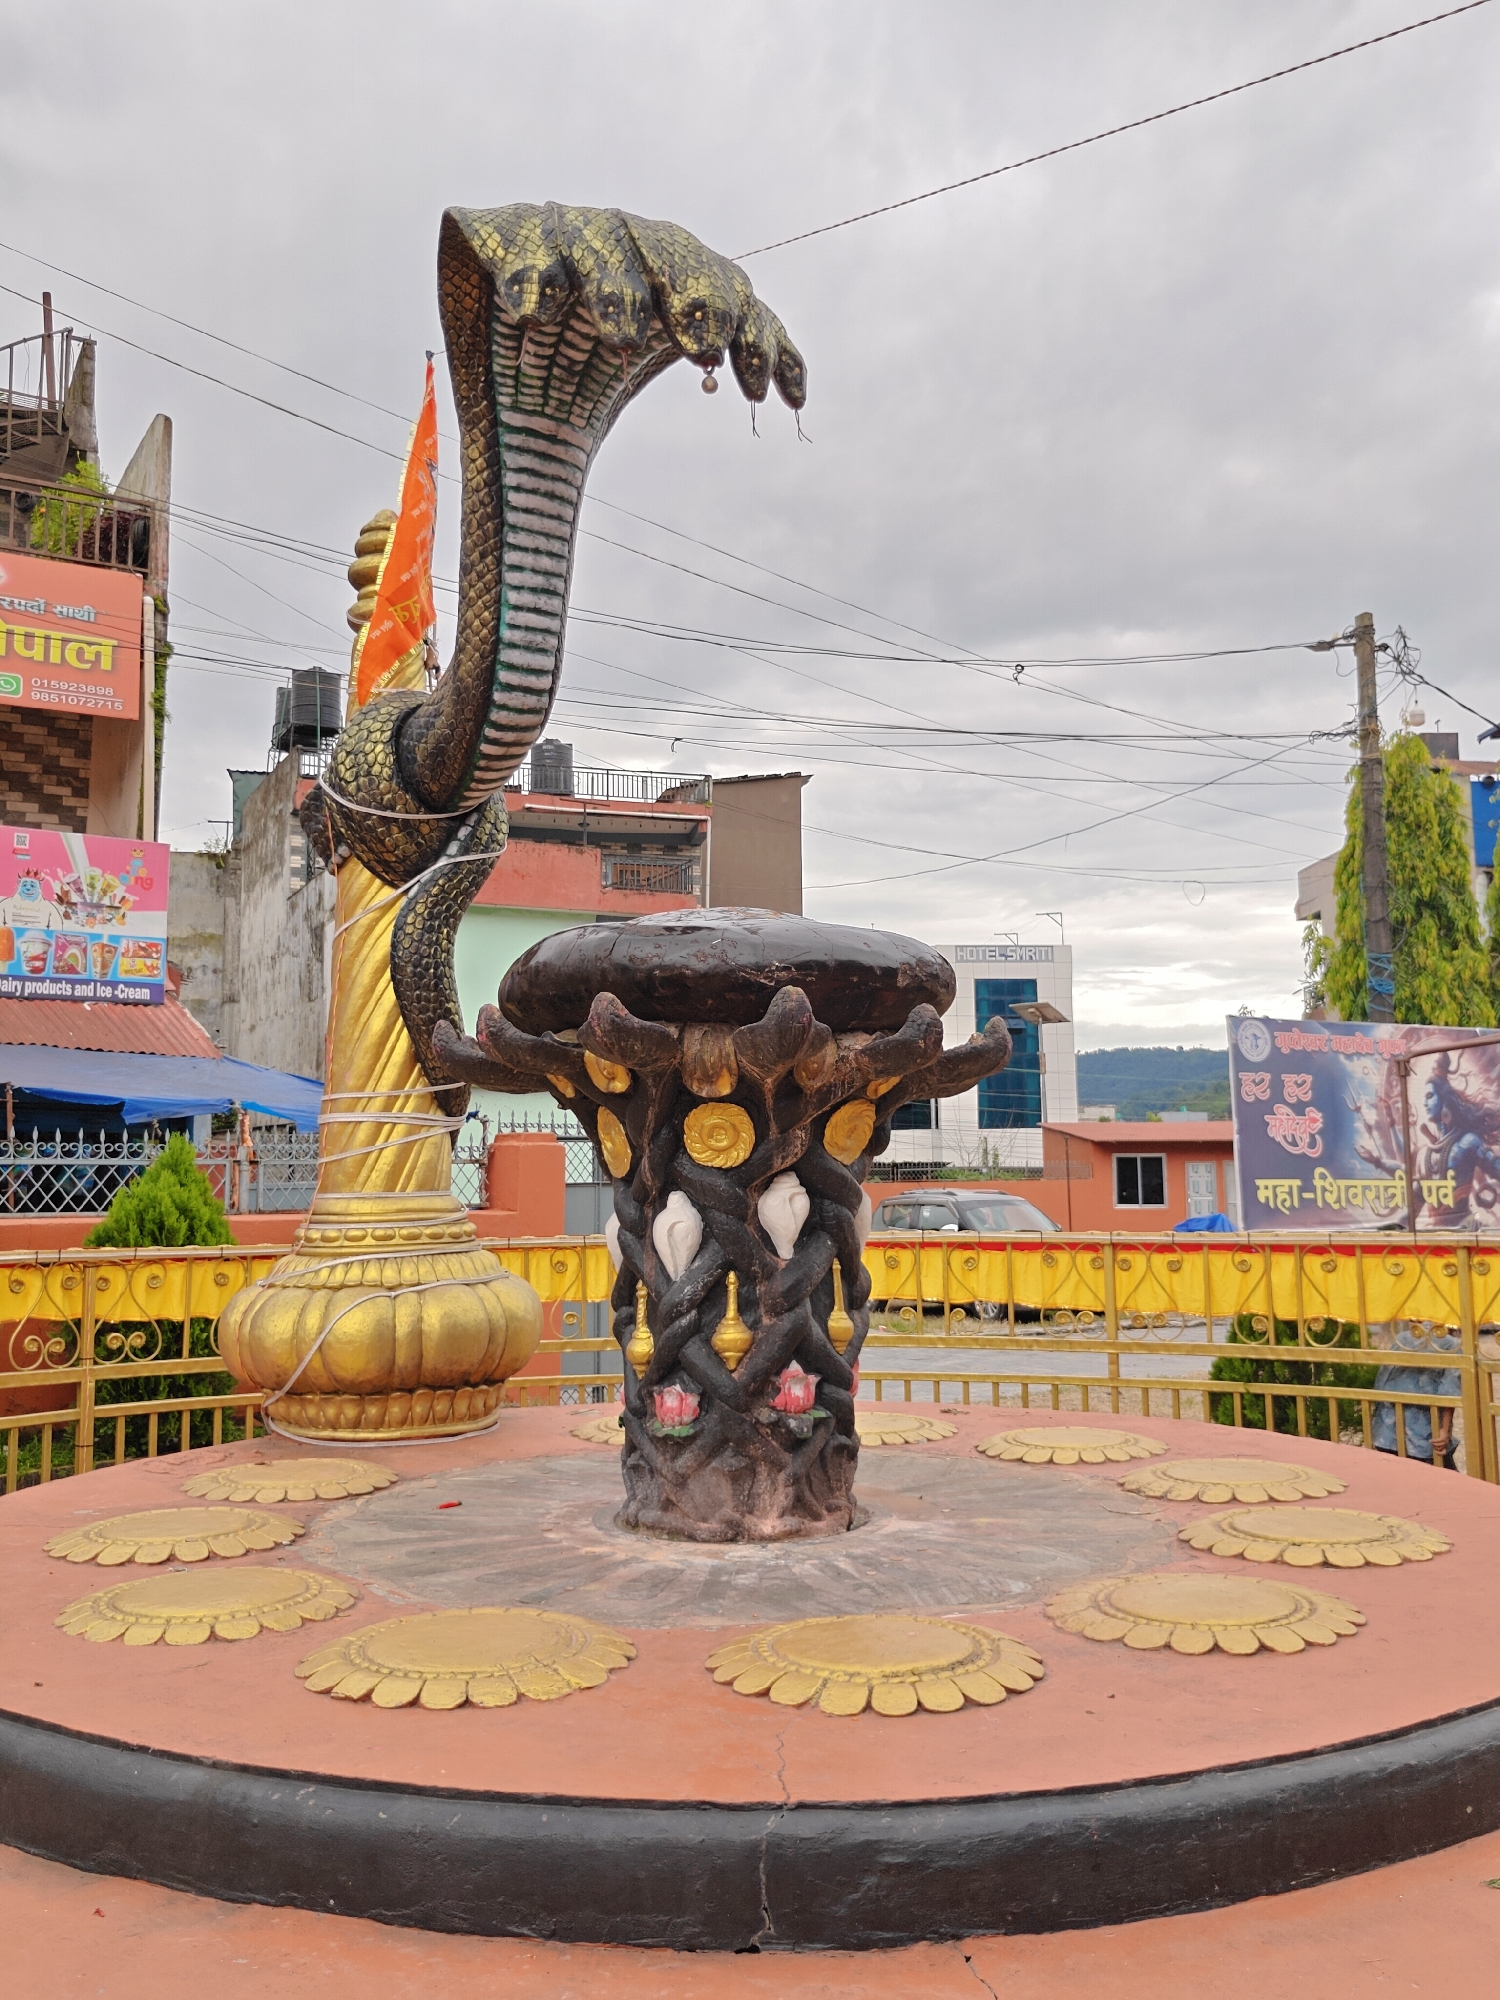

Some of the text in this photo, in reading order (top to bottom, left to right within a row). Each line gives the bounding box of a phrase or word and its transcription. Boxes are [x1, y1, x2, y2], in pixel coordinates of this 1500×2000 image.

[53, 604, 96, 622] साथी
[0, 618, 118, 671] पाल
[31, 678, 114, 697] 015923898
[31, 691, 123, 711] 9851072715
[956, 946, 1052, 961] HOTEL SMRITI
[0, 977, 23, 996] airy
[25, 979, 72, 996] products
[74, 981, 94, 997] and
[96, 982, 112, 997] Ice
[1238, 1071, 1312, 1103] हर हर
[1420, 1169, 1457, 1209] पर्व
